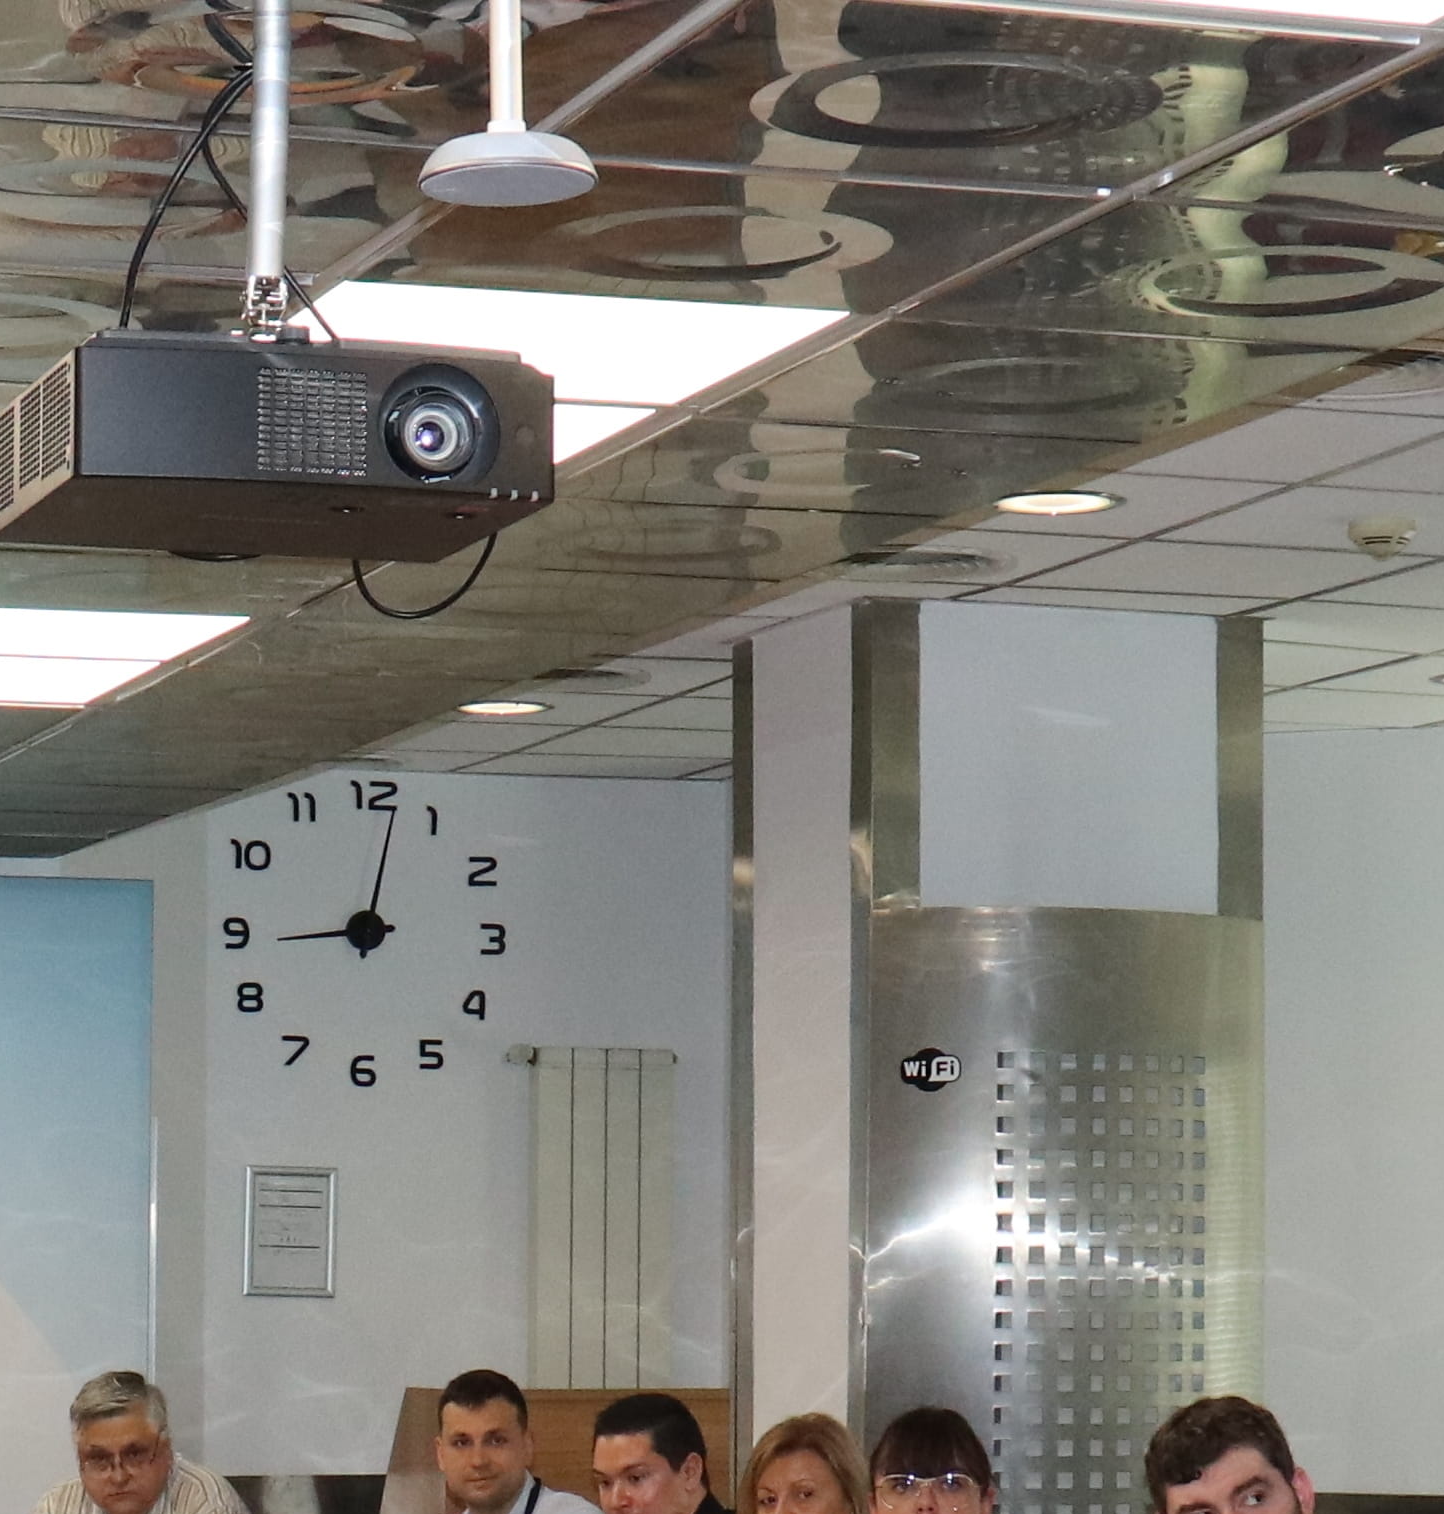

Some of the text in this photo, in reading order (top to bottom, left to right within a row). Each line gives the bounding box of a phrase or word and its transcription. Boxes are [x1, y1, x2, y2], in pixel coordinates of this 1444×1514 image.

[287, 792, 316, 822] 11
[351, 780, 398, 811] 12
[426, 805, 438, 835] 1
[230, 838, 271, 870] 10
[468, 856, 498, 886] 2
[223, 917, 250, 949] 9
[480, 923, 506, 955] 3
[237, 982, 264, 1012] 8
[462, 990, 486, 1020] 4
[281, 1035, 310, 1066] 7
[419, 1039, 444, 1069] 5
[350, 1055, 377, 1087] 6
